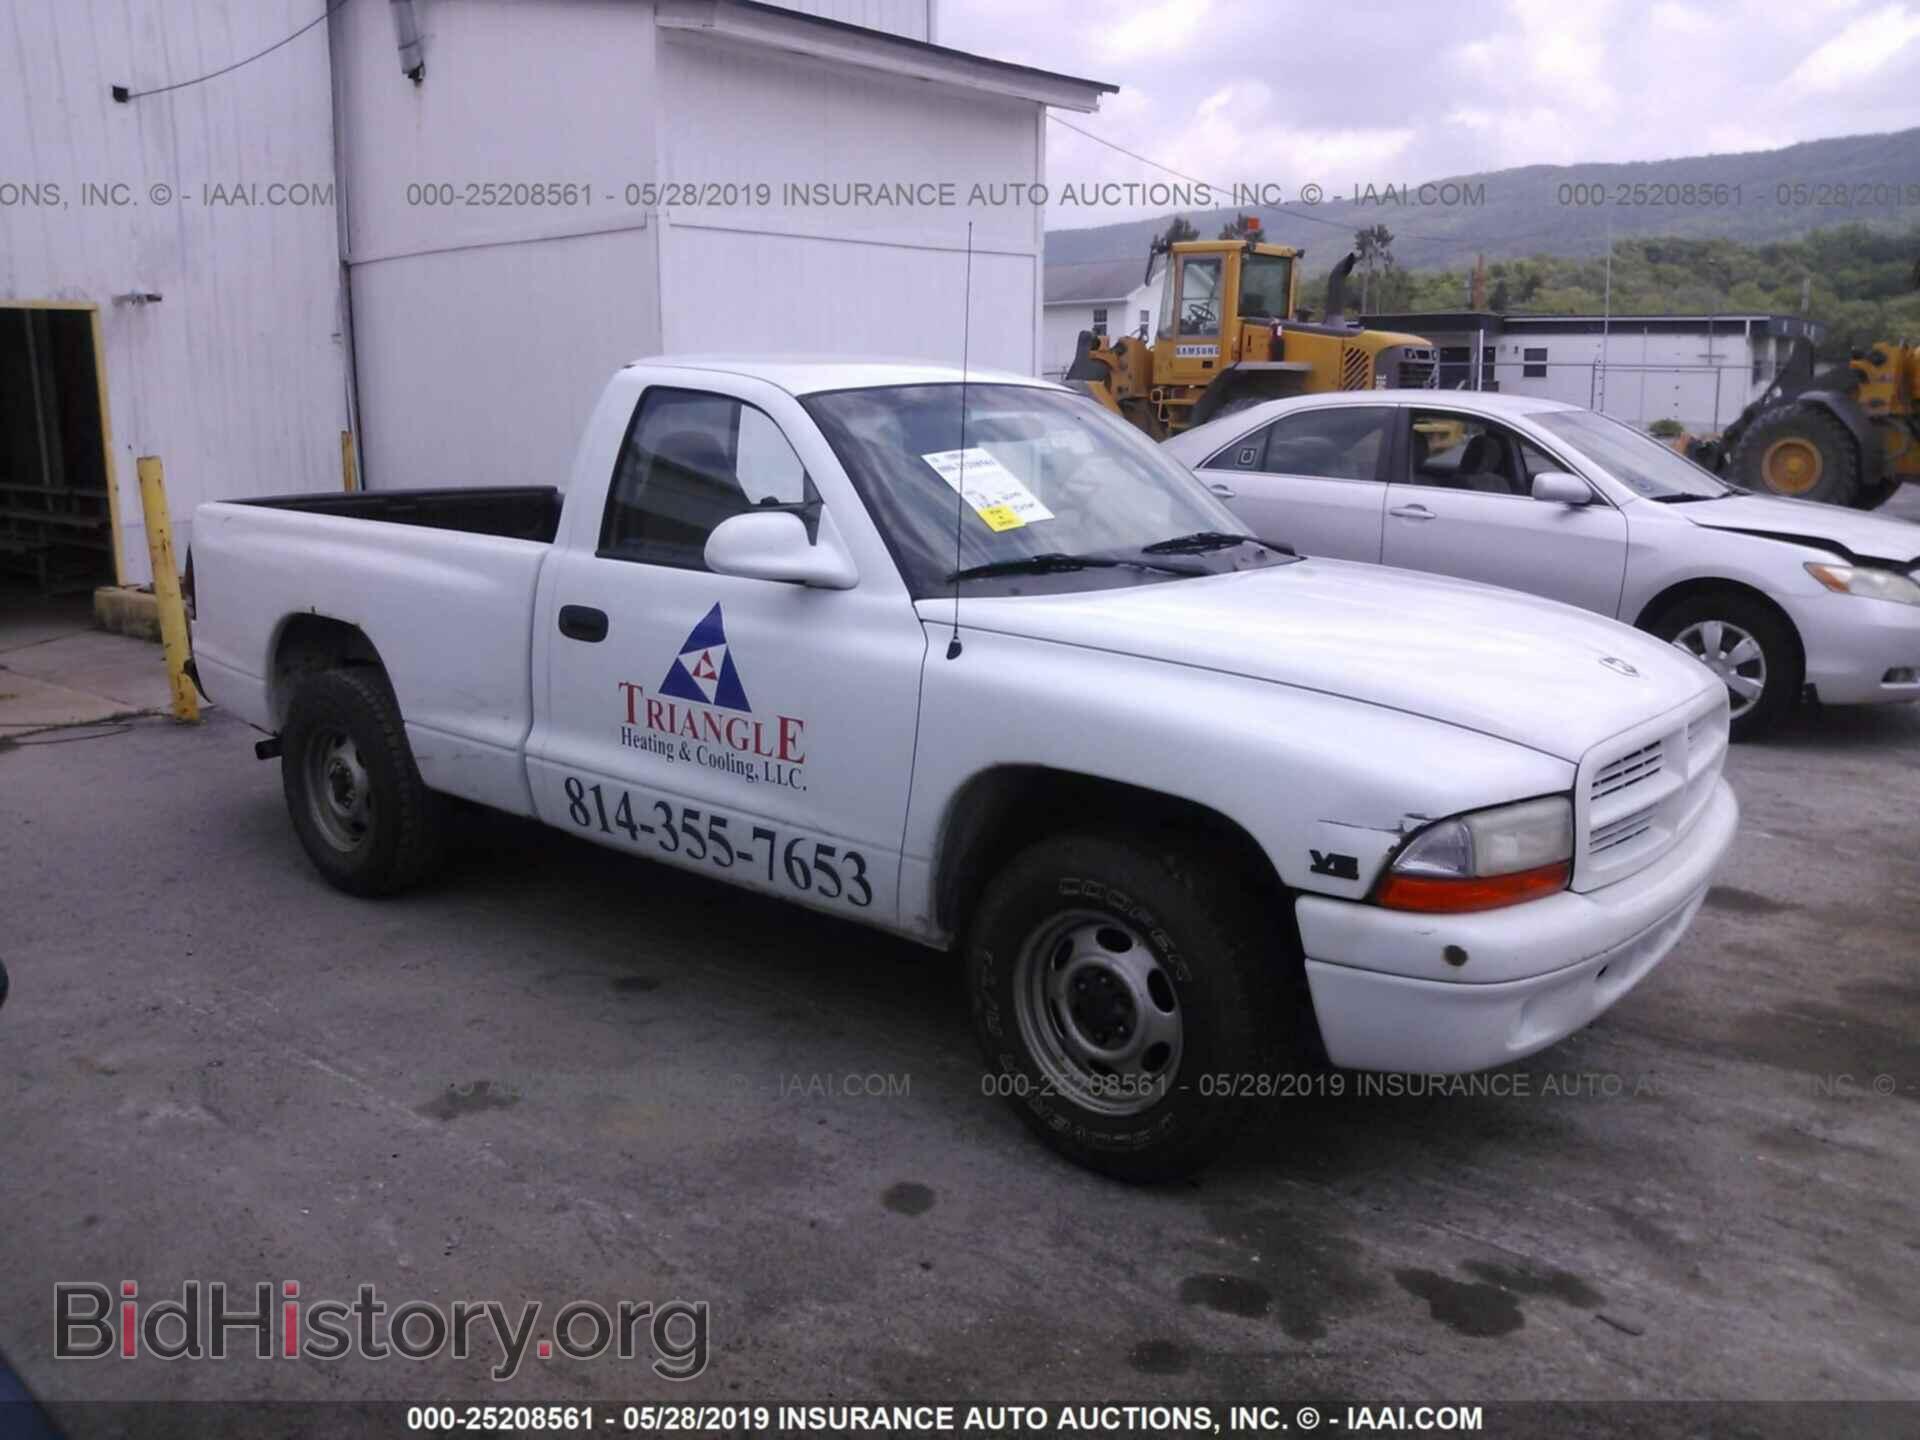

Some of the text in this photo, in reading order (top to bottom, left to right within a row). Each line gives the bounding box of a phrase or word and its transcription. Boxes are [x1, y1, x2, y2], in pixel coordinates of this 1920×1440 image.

[618, 681, 806, 764] TRIANGLE
[621, 726, 807, 792] Heating & Cooling, LLC.
[564, 776, 873, 908] 814-355-7653
